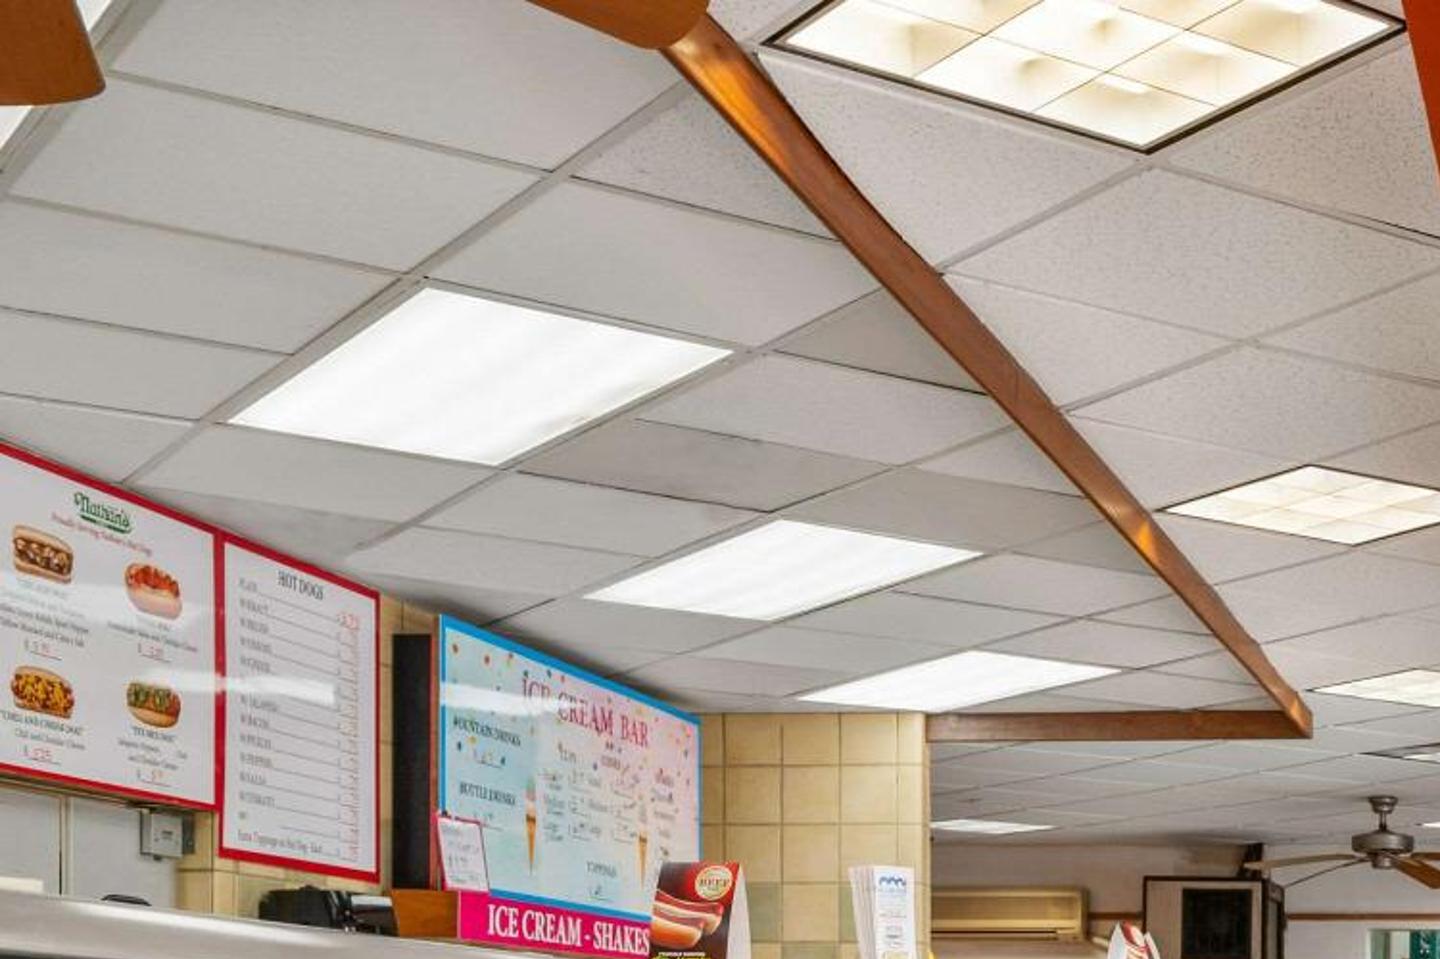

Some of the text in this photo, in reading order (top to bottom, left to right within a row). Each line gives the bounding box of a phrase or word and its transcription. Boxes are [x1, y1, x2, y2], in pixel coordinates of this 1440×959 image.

[557, 691, 614, 737] CREAM
[620, 713, 648, 748] BAR
[487, 903, 520, 939] ICE
[521, 909, 583, 948] CREAM
[592, 920, 650, 956] SHAKES
